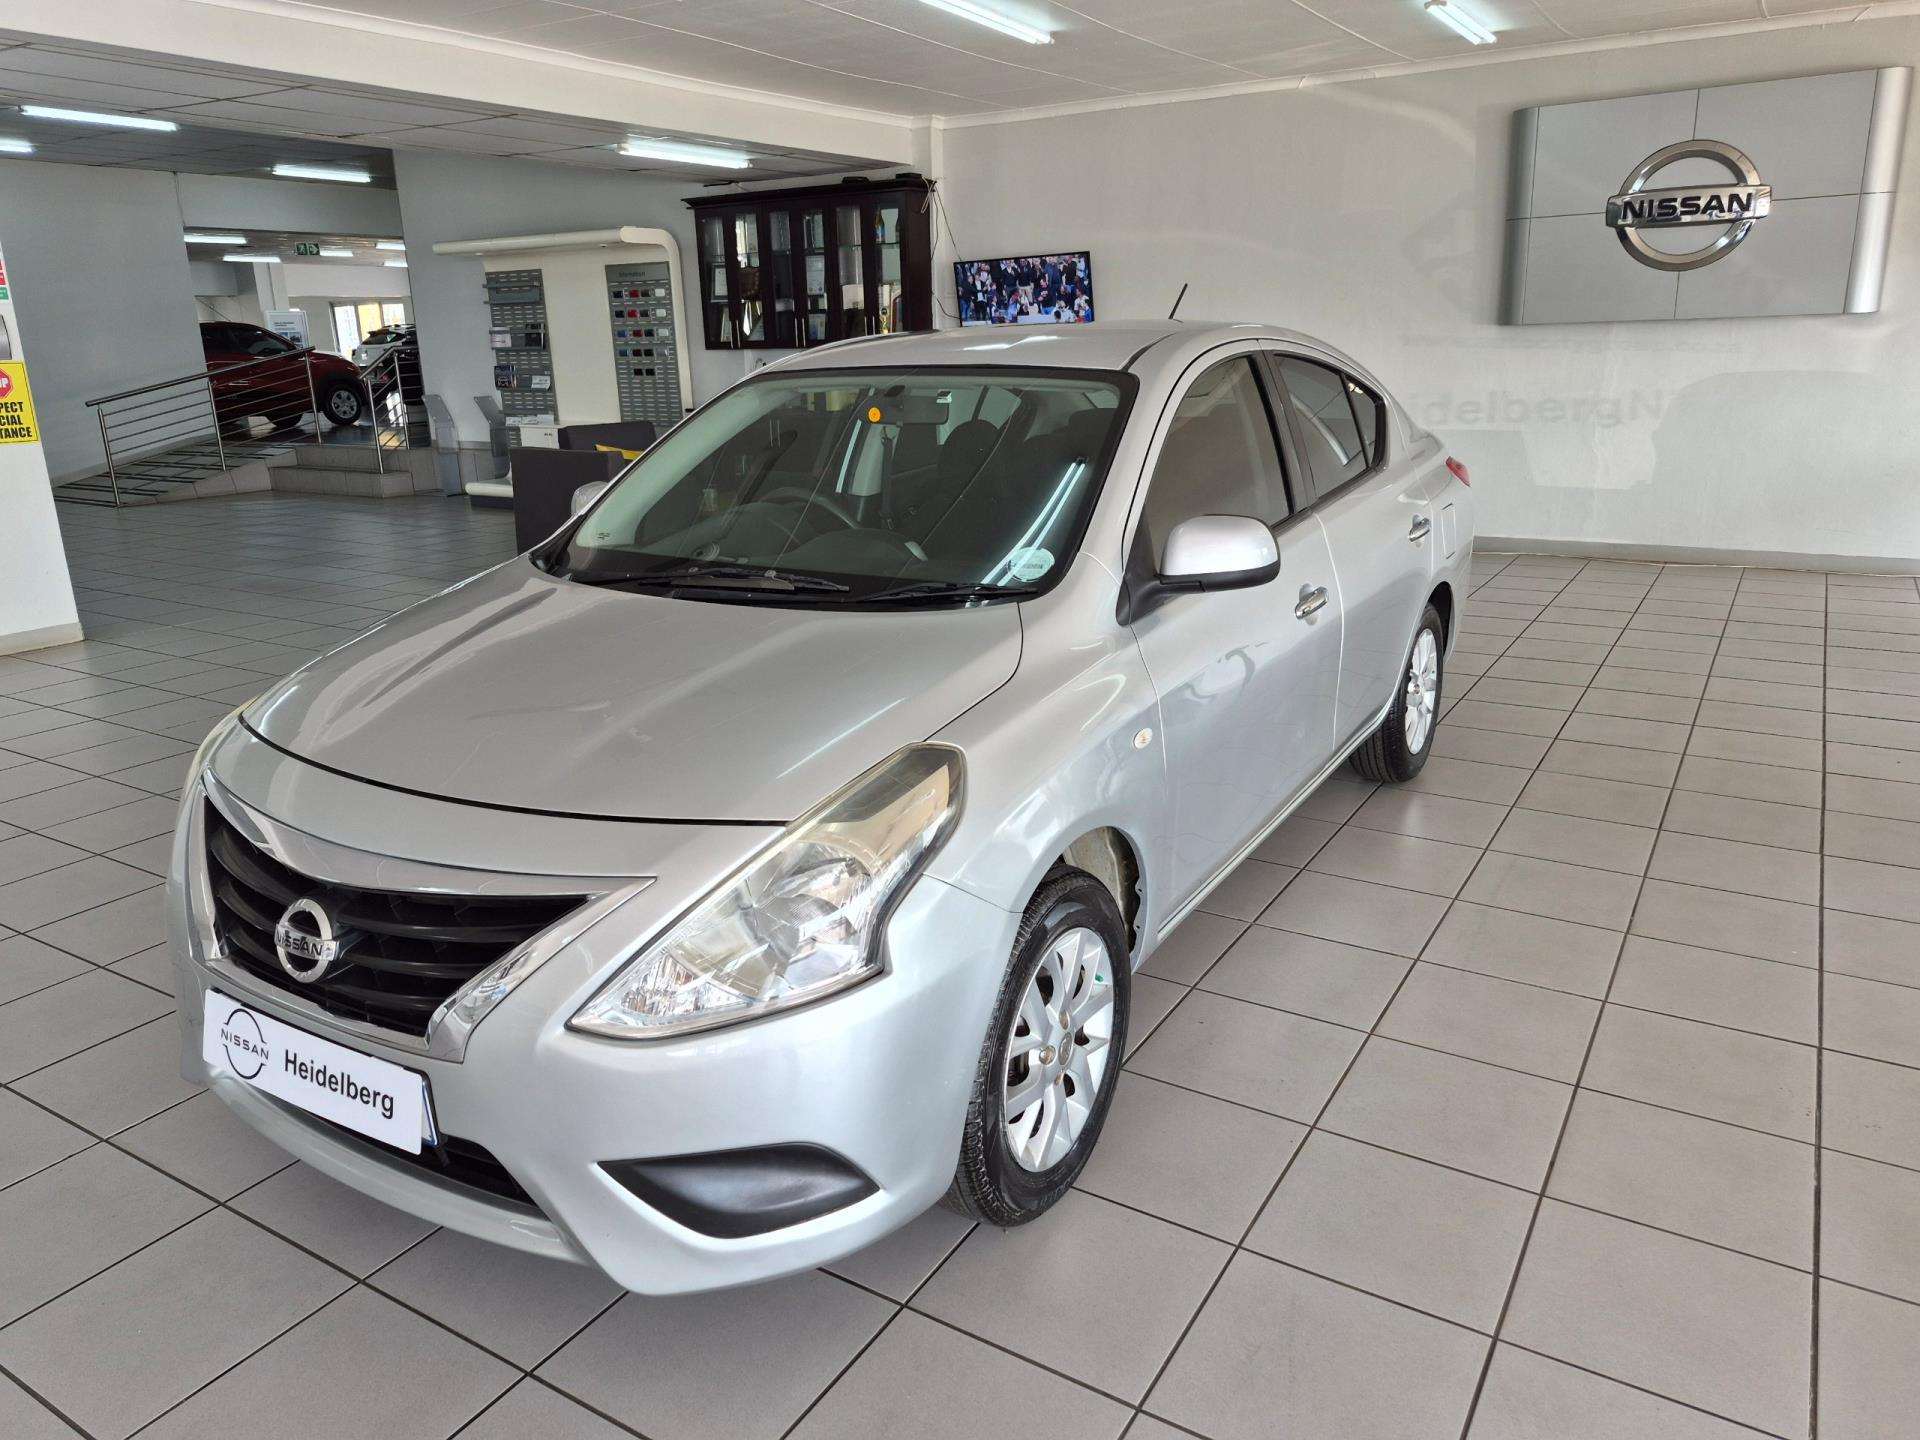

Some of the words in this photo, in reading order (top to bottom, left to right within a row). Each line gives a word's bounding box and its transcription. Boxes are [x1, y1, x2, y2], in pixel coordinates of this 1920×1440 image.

[1622, 193, 1753, 220] NISSAN
[220, 1027, 270, 1061] NISSAN
[284, 1048, 395, 1120] Heidelberg
